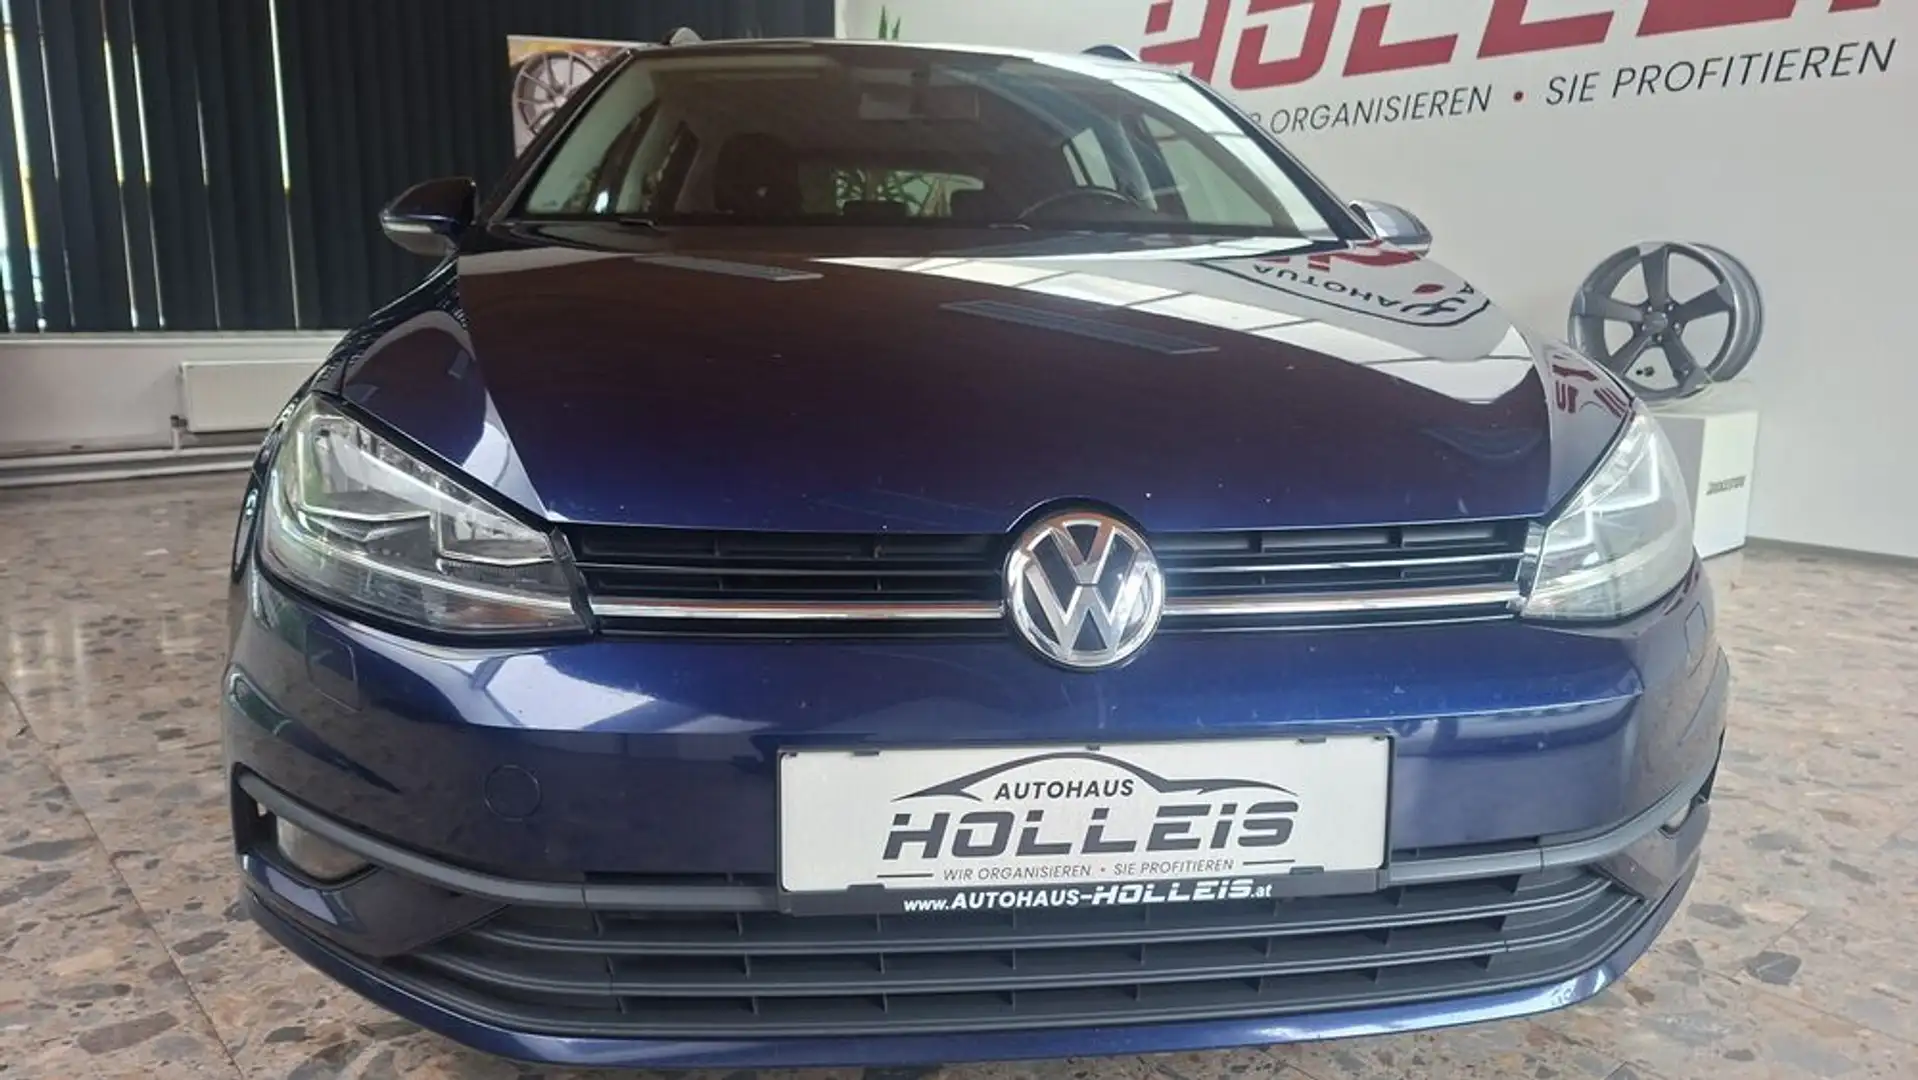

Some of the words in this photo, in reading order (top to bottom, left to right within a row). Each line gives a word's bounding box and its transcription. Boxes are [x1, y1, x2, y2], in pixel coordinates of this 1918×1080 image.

[1270, 84, 1491, 134] ORGANISIEREN
[1545, 71, 1600, 105] SIE
[1612, 38, 1896, 99] PROFITIEREN
[994, 779, 1135, 801] AUTOHAUS
[882, 801, 1299, 860] HOLLEIS
[943, 867, 974, 881] WIR
[977, 864, 1091, 880] ORGANISIEREN
[1114, 862, 1136, 876] SIE
[1139, 859, 1234, 875] PROFITIEREN
